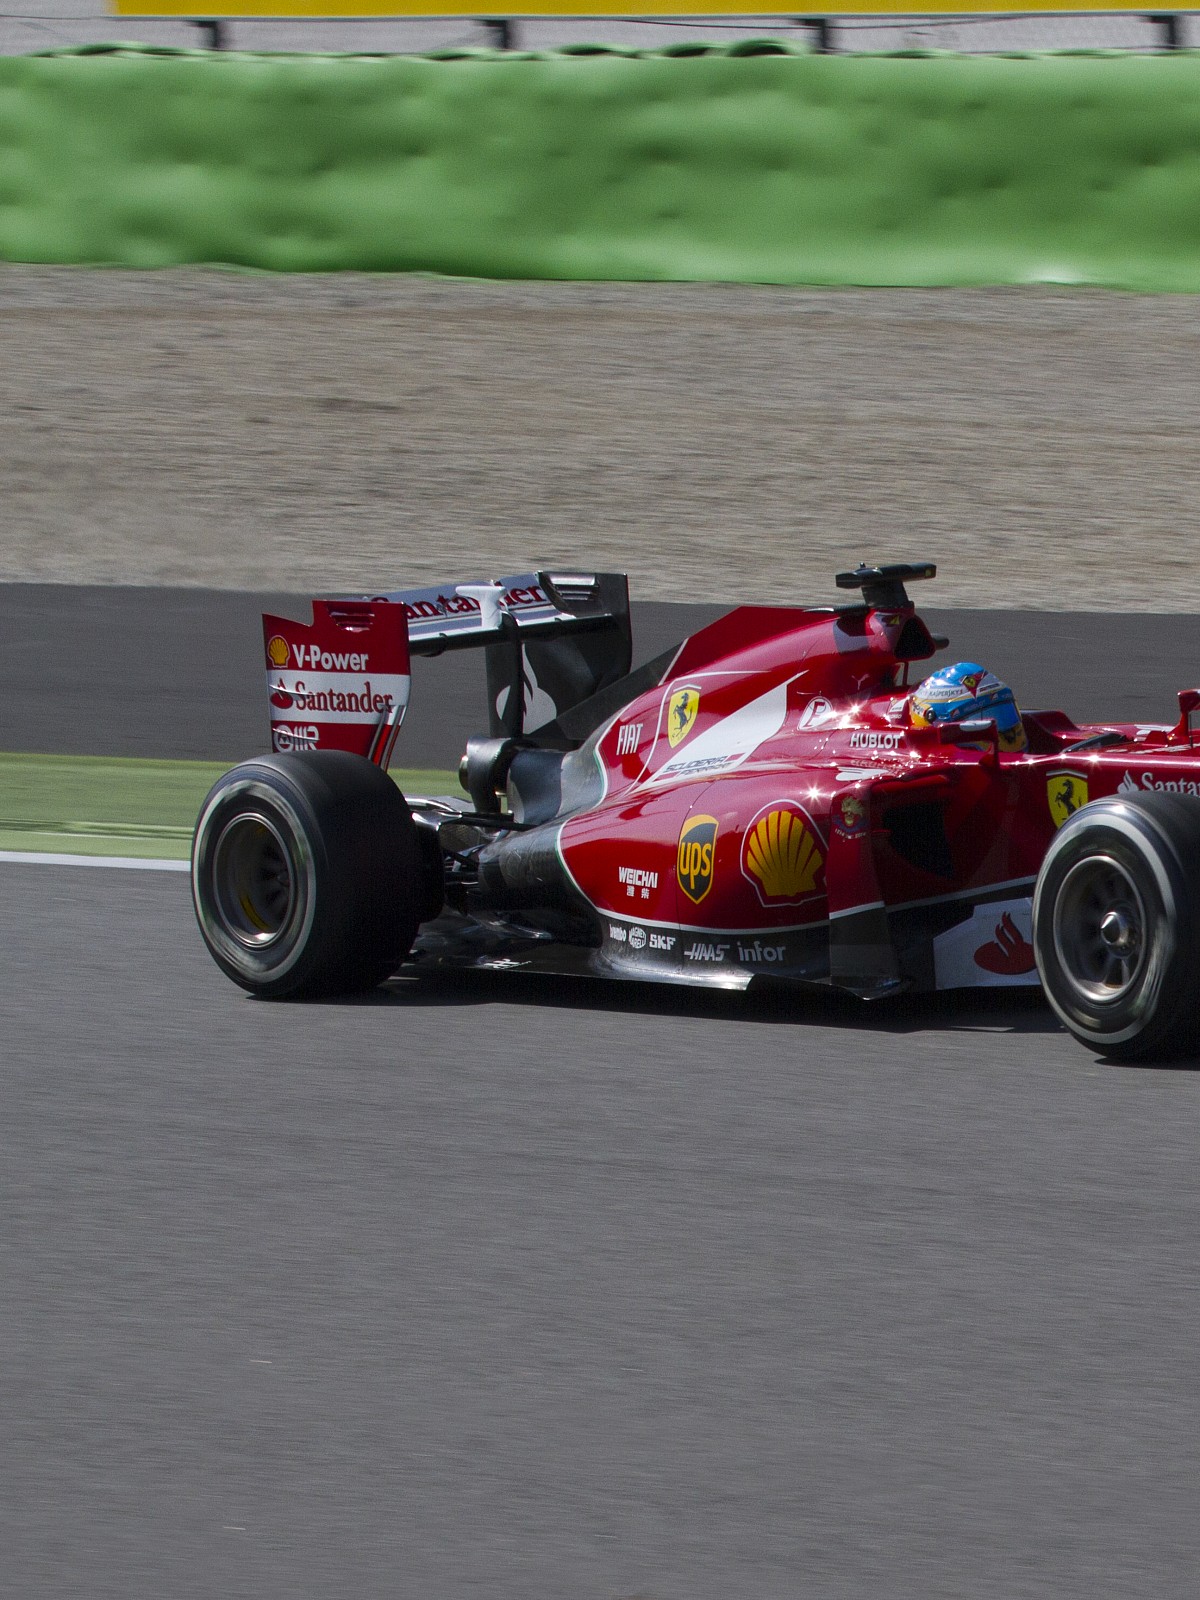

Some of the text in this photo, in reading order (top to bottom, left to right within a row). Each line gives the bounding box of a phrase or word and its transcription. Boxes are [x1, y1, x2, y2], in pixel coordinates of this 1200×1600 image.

[292, 643, 370, 672] V-Power
[294, 680, 393, 714] Santander
[616, 723, 643, 755] FIAT
[850, 732, 902, 750] HUBLOT
[618, 866, 659, 889] WEICHAI
[680, 842, 712, 890] ups
[649, 933, 677, 951] SKF
[683, 940, 787, 962] HAAS infor
